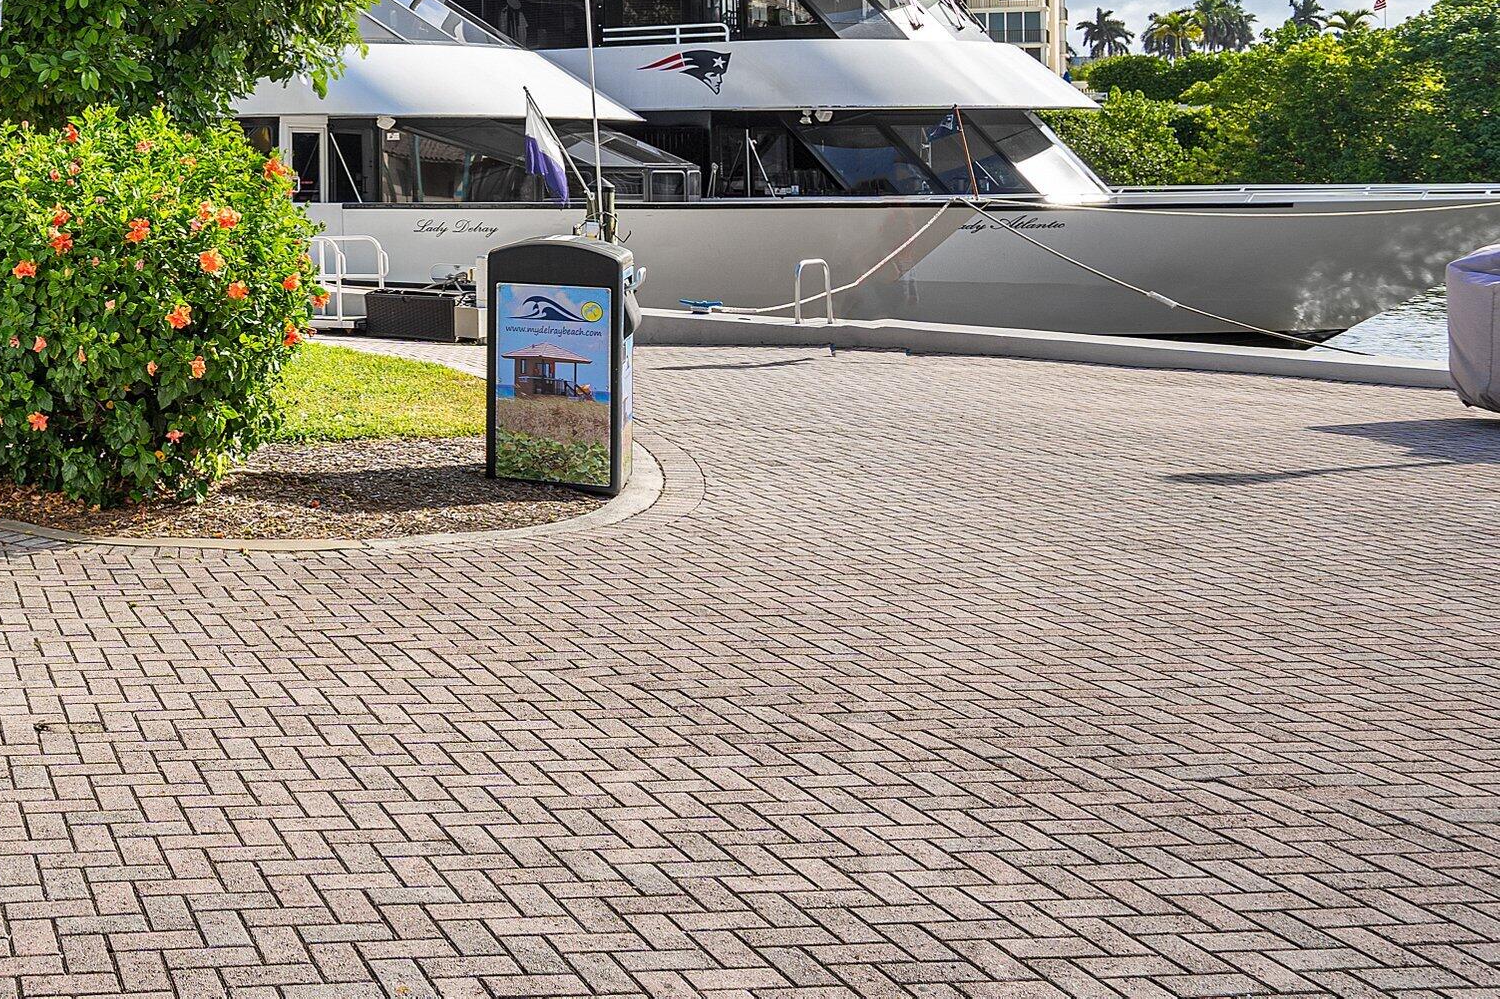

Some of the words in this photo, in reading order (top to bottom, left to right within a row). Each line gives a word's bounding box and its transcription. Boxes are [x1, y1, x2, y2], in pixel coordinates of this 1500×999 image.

[413, 218, 448, 237] Lady
[452, 219, 499, 238] Delray
[505, 325, 603, 337] www.mydelraybeach.com
